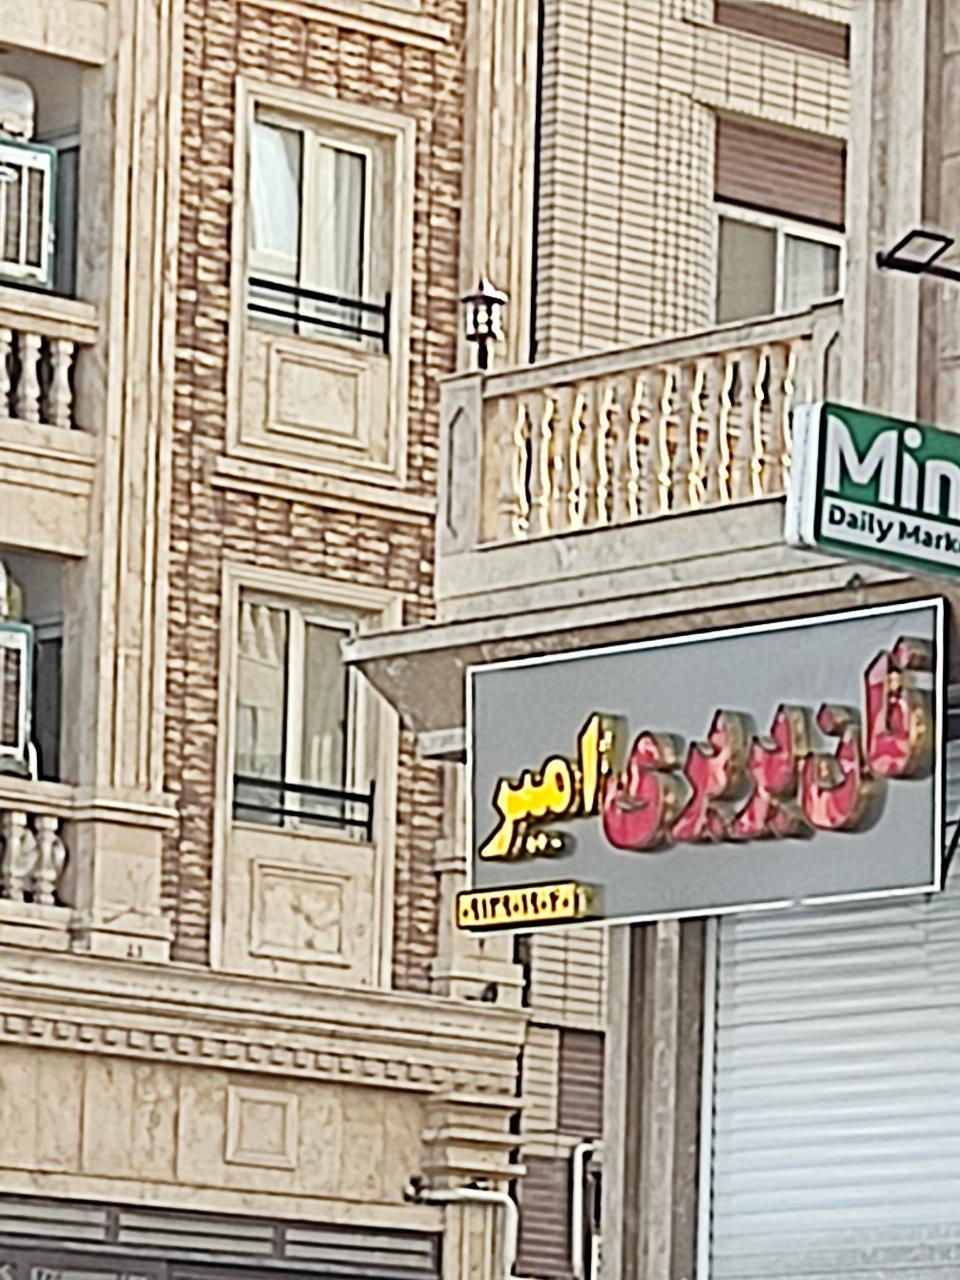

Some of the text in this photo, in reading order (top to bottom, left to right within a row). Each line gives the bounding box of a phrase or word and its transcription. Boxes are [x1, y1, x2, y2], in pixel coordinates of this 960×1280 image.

[827, 503, 894, 544] Daily
[479, 712, 605, 860] امیر
[602, 703, 815, 850] بربری
